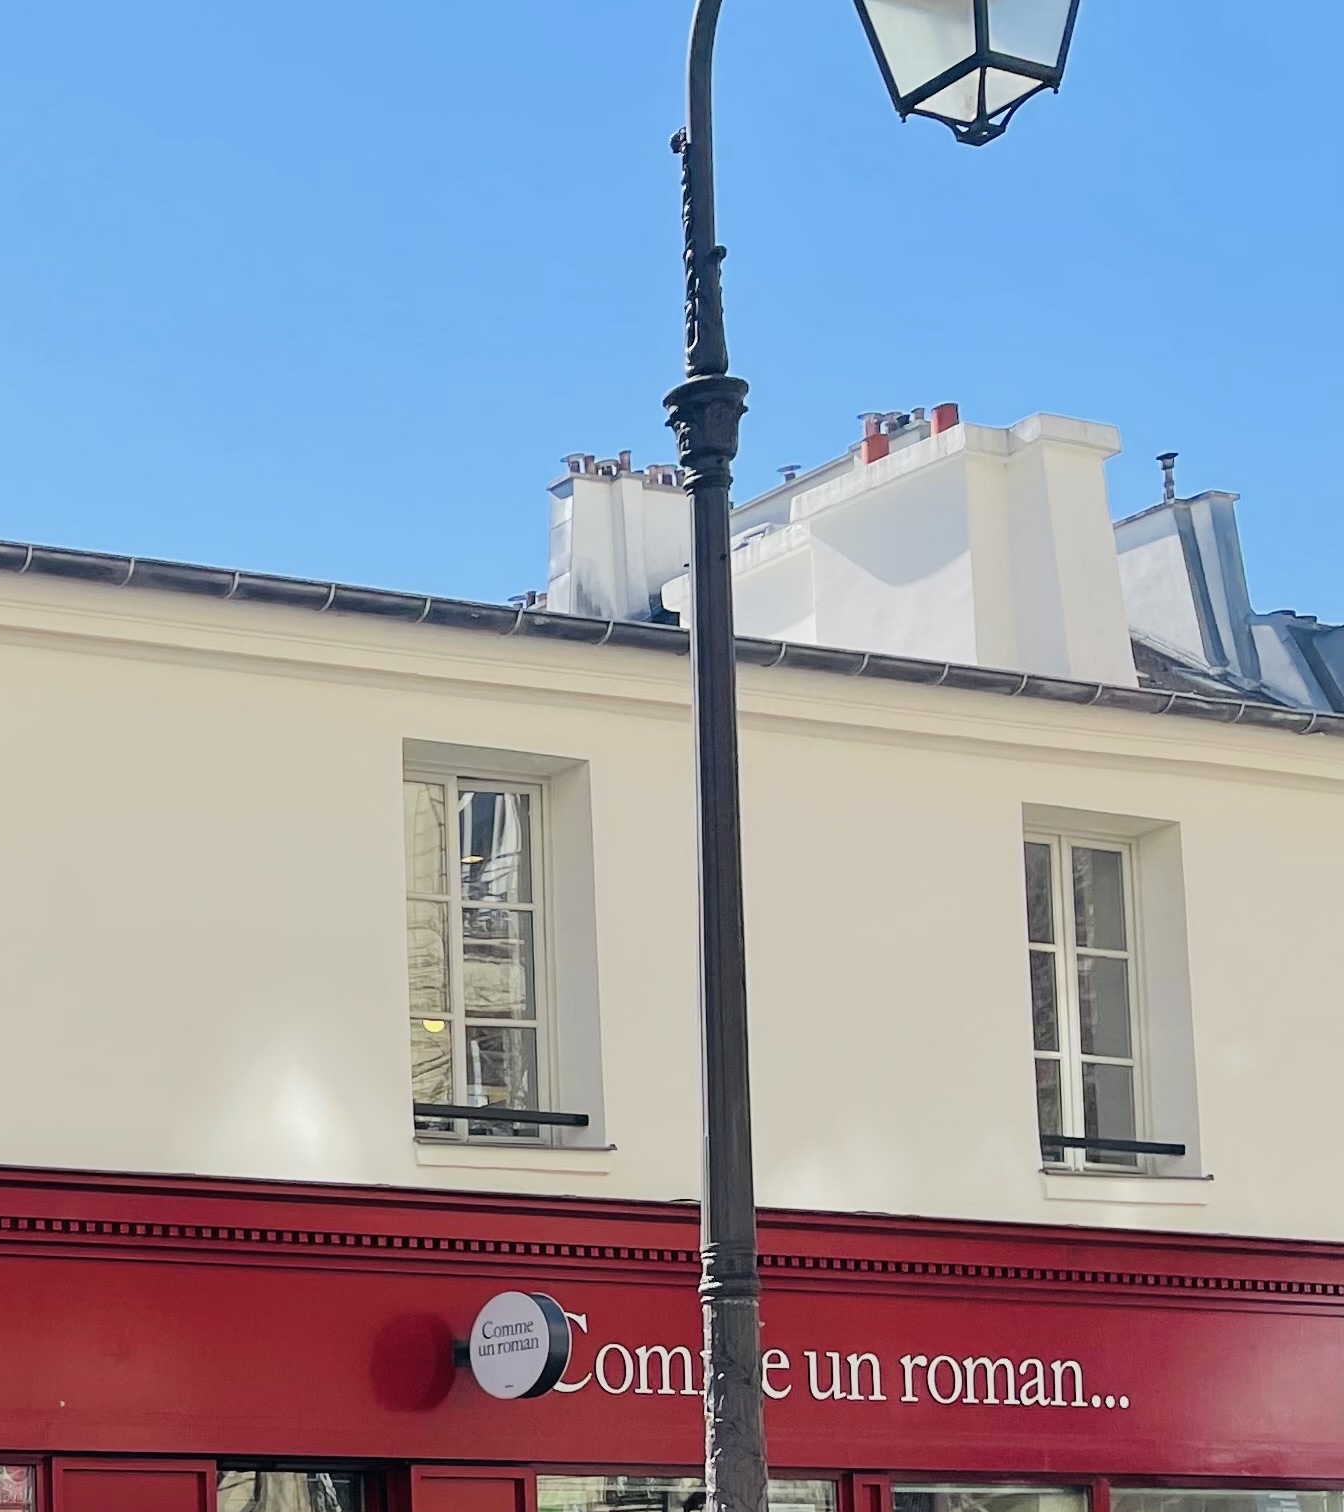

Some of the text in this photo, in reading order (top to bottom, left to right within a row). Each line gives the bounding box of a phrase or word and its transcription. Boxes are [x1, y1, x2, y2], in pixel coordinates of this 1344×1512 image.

[481, 1320, 534, 1340] Comme
[478, 1337, 540, 1357] un roman
[552, 1311, 1130, 1409] Come un roman...
